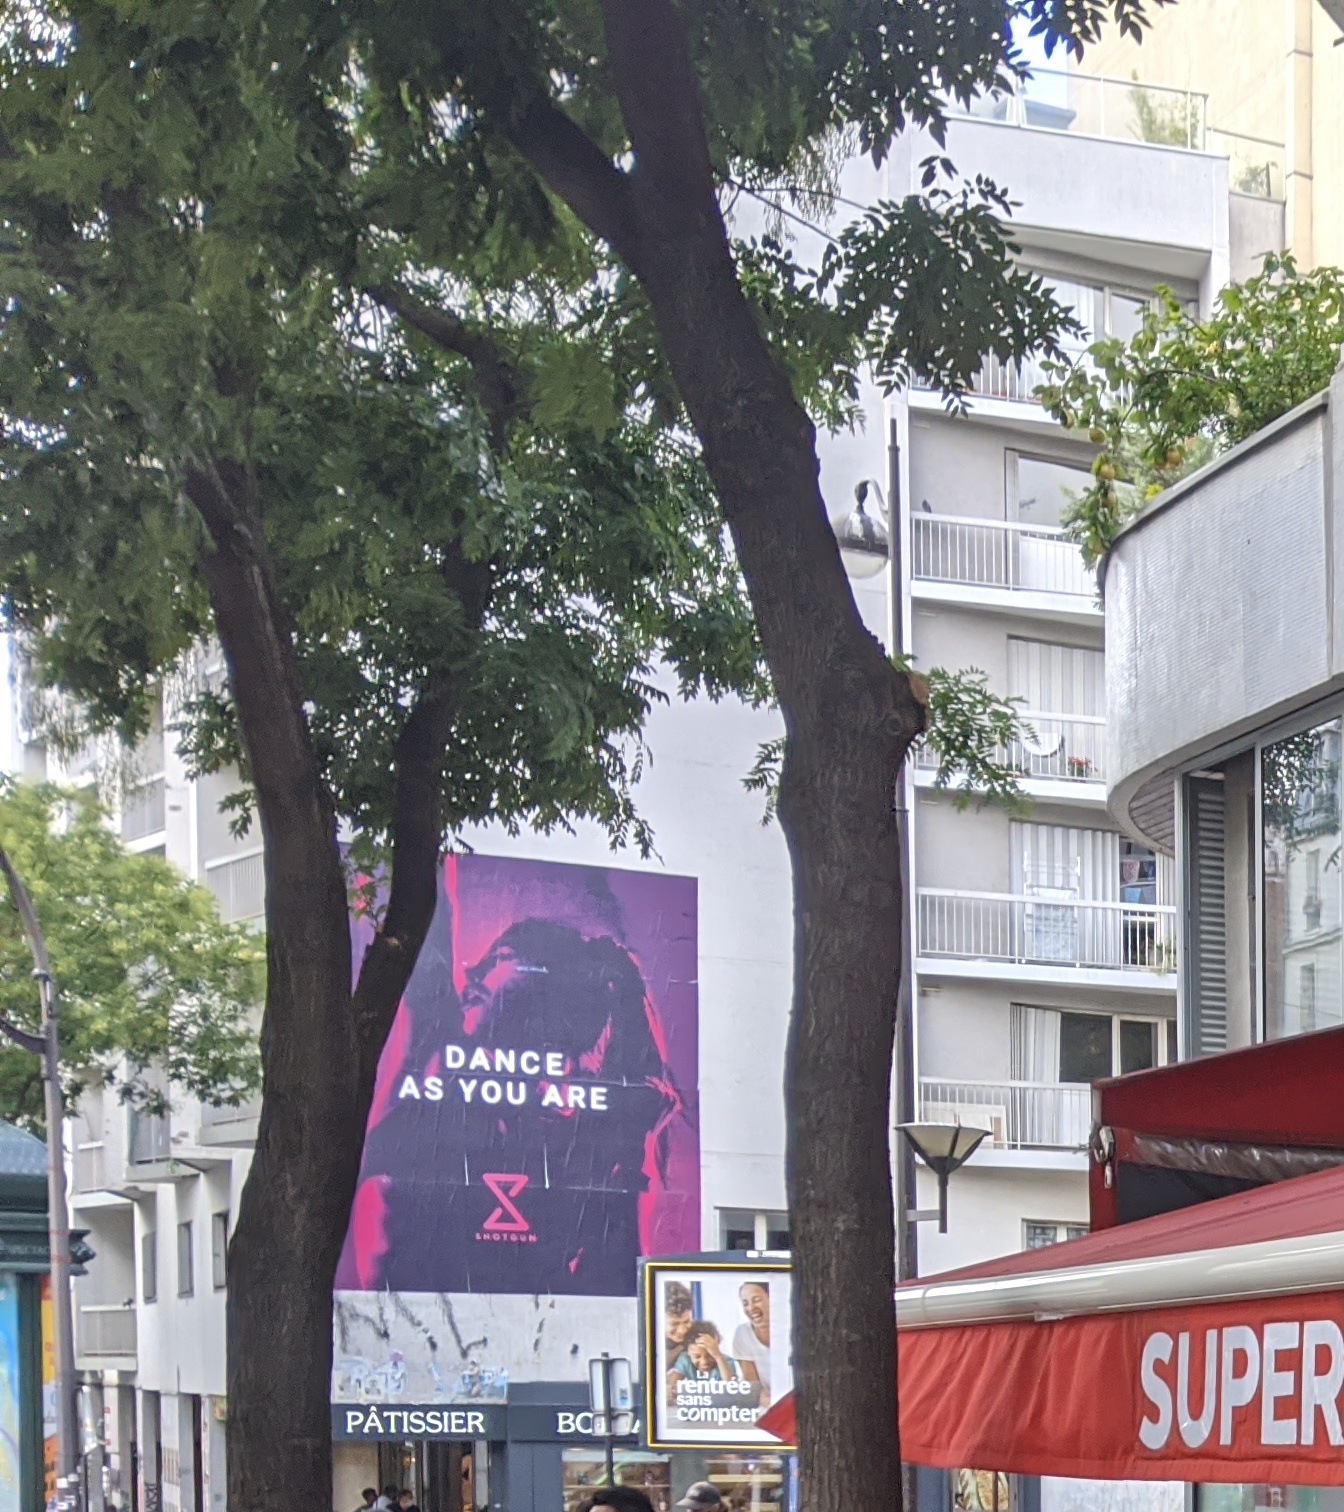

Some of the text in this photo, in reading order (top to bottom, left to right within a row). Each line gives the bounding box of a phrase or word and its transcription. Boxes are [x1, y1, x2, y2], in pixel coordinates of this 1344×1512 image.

[446, 1045, 564, 1076] DANCE
[398, 1075, 608, 1111] AS YOU ARE
[696, 1370, 709, 1379] La
[676, 1376, 752, 1395] rentrée
[676, 1395, 712, 1406] sans
[345, 1405, 485, 1434] PÂTISSIER
[676, 1405, 760, 1426] compter
